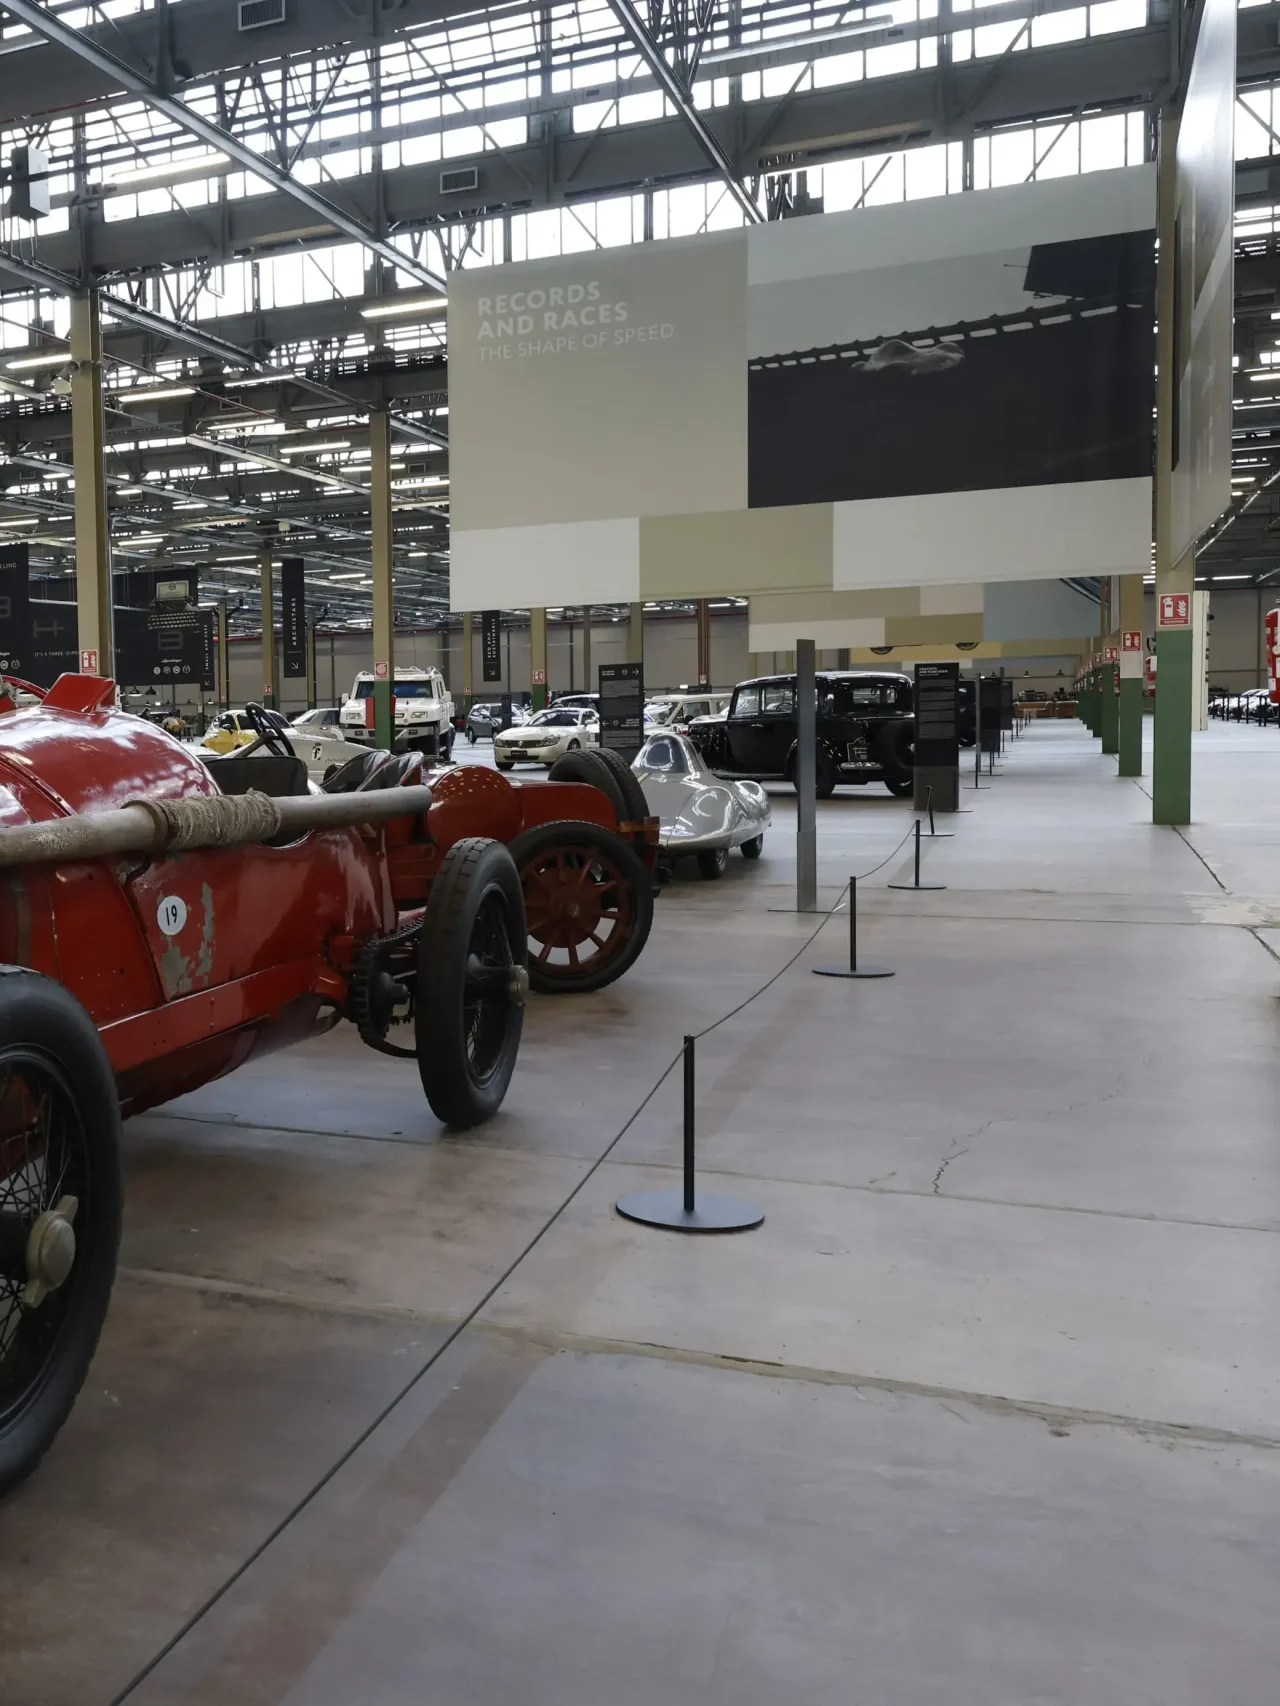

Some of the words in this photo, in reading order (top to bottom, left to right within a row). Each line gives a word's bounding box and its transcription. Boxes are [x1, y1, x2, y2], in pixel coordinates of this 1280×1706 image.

[478, 281, 600, 316] RECORDS
[477, 315, 534, 340] AND
[543, 302, 628, 331] RACES
[478, 344, 512, 362] THE
[517, 335, 579, 357] SHAPE
[582, 332, 610, 349] OF
[166, 905, 178, 926] 19
